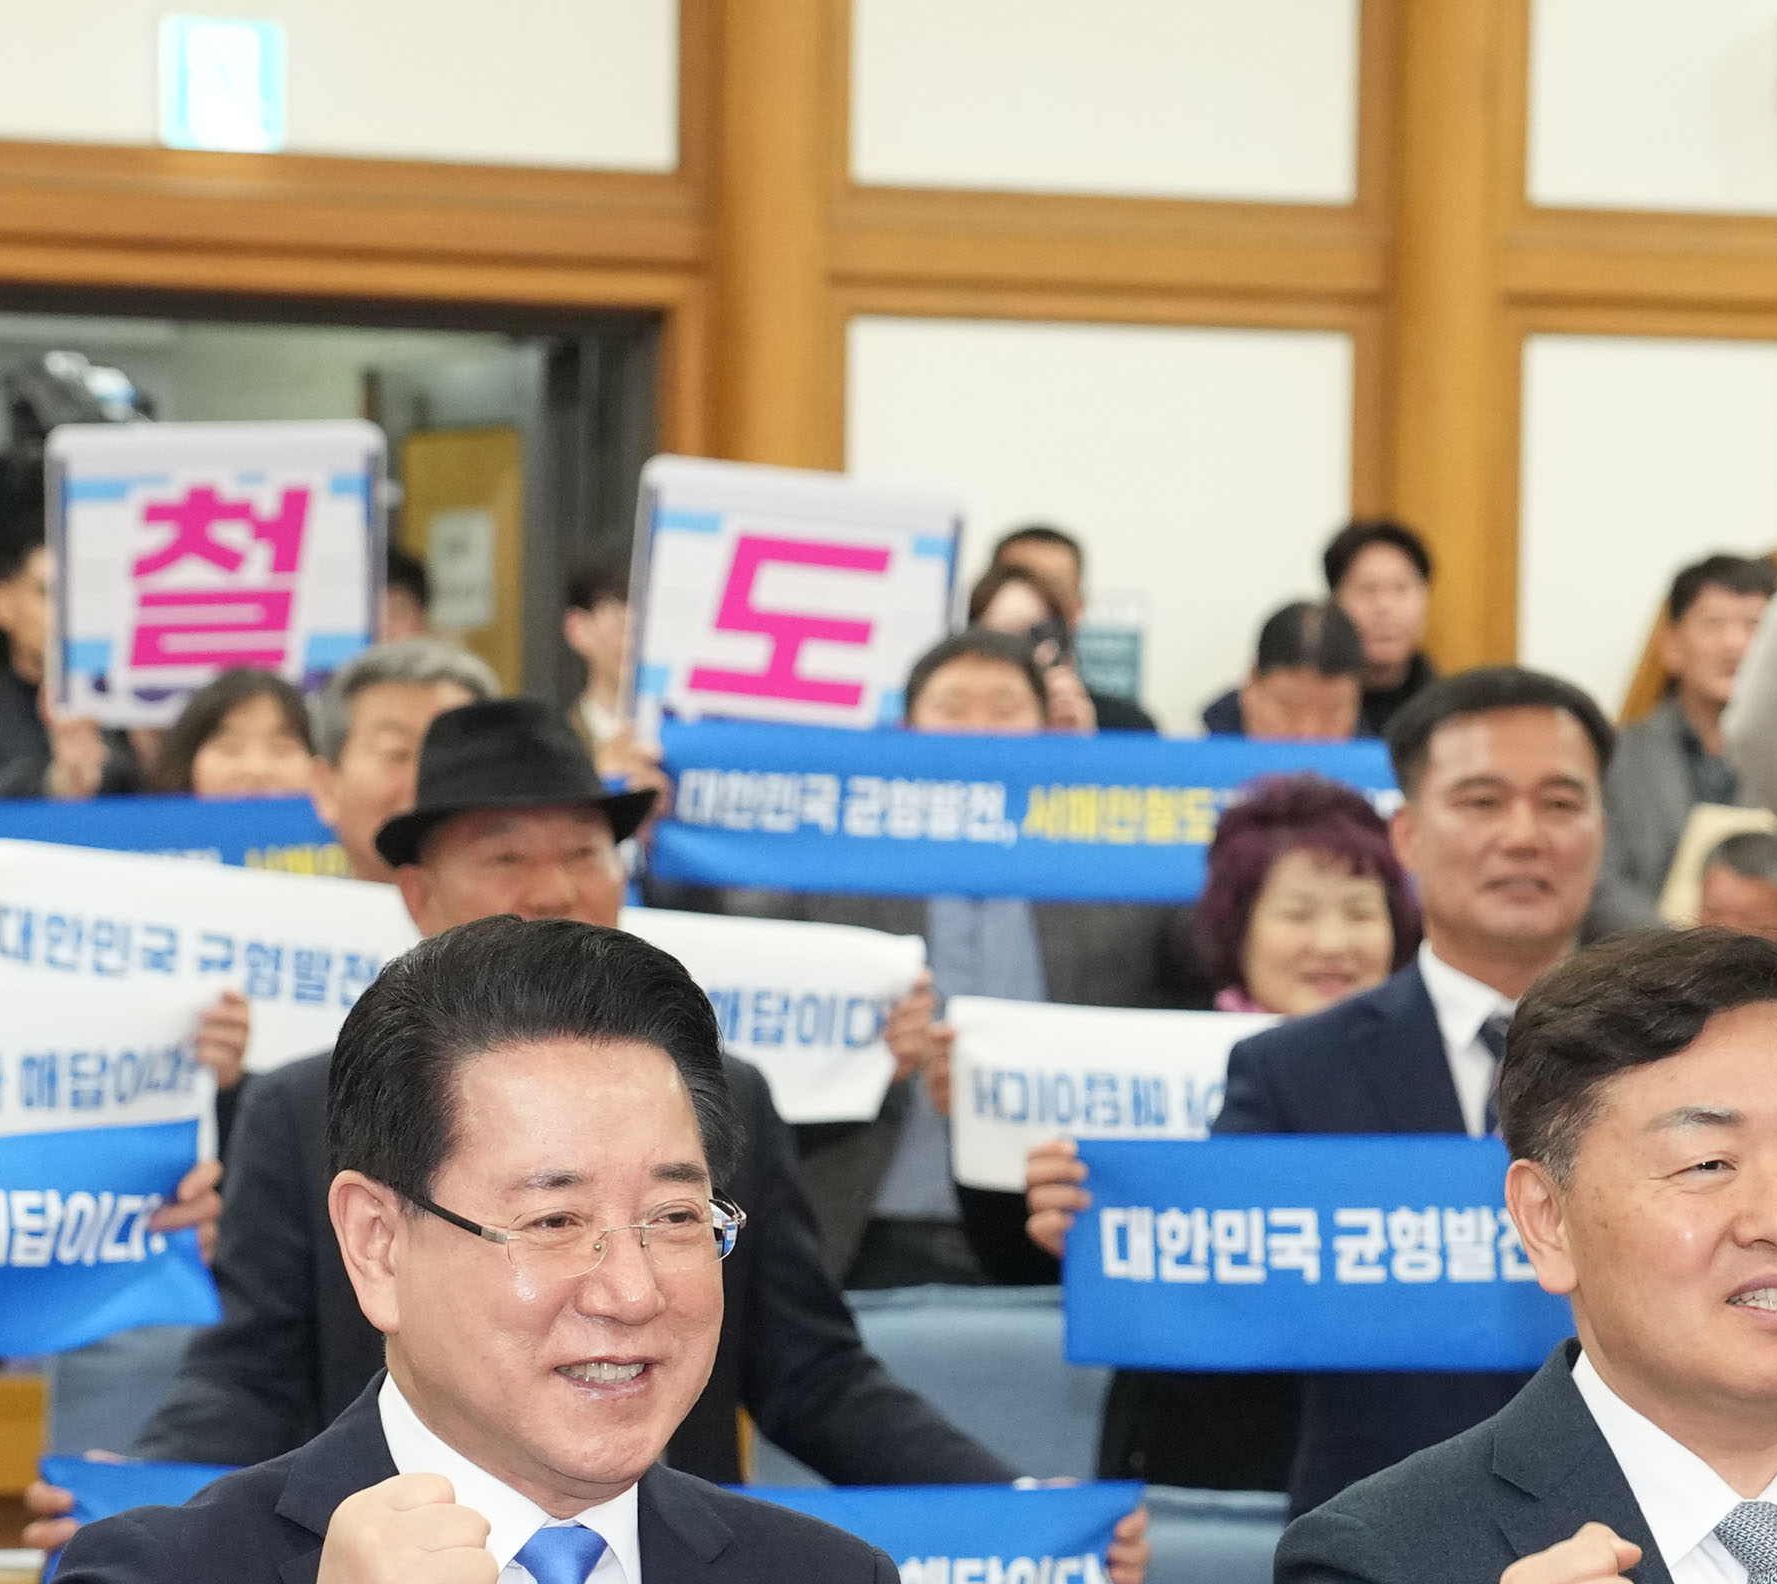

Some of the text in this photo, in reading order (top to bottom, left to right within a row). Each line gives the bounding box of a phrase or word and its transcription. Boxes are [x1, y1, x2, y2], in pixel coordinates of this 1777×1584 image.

[129, 484, 312, 672] 철
[686, 534, 893, 708] 도
[1023, 783, 1240, 846] 서해안철도
[1099, 1206, 1321, 1284] 대한민국
